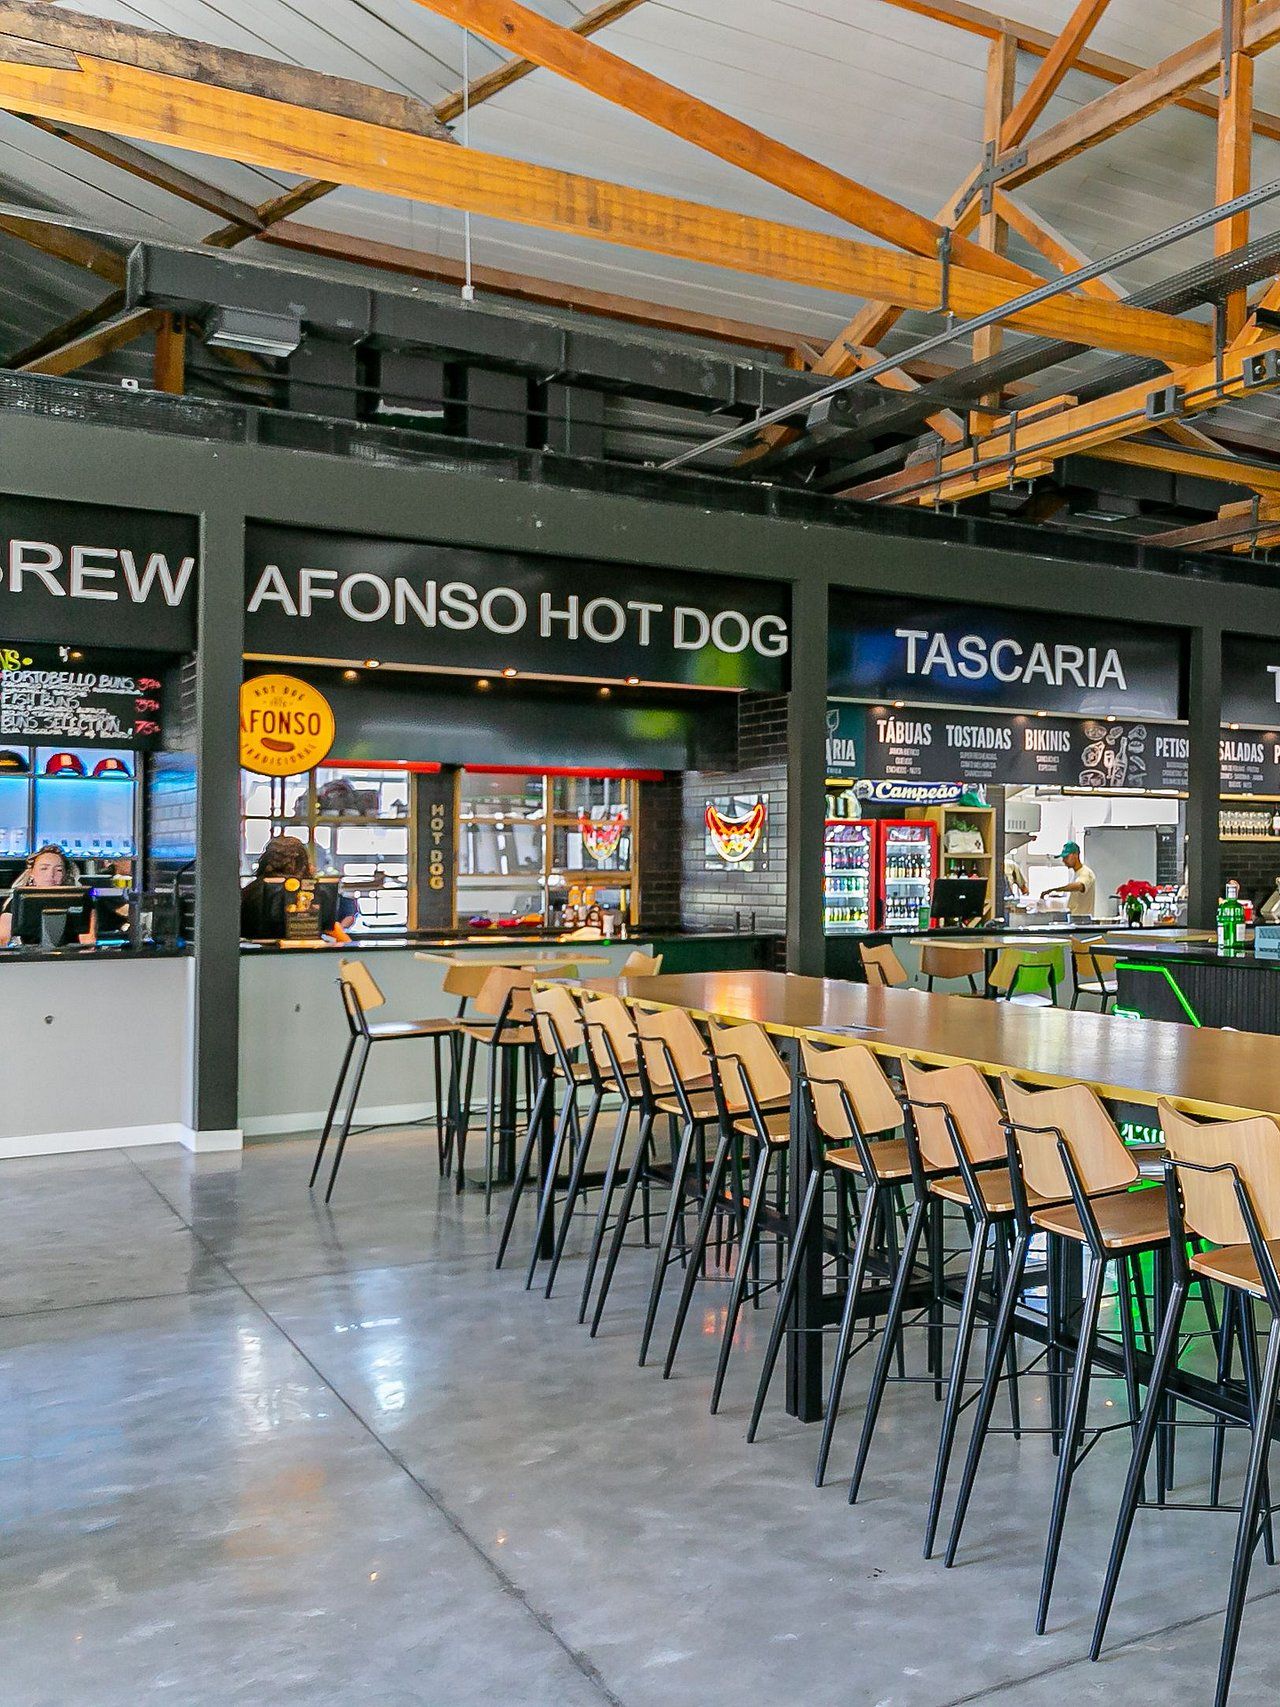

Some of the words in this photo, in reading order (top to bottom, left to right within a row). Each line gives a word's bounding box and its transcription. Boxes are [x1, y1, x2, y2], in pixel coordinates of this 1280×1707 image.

[0, 538, 195, 607] REW
[247, 564, 527, 635] AFONSO
[540, 592, 663, 647] HOT
[673, 606, 788, 658] DOG
[2, 670, 96, 687] PORTOBELLO
[98, 675, 135, 689] BUNS
[895, 628, 1127, 691] TASCARIA
[41, 694, 80, 709] BUNS
[1, 715, 38, 728] BUNS
[44, 714, 121, 732] SELECTION
[877, 716, 932, 746] TÁBUAS
[945, 725, 1012, 750] TOSTADAS
[1025, 729, 1071, 752] BIKINIS
[1155, 737, 1189, 758] PETIS
[1219, 740, 1265, 763] SALADAS
[875, 781, 961, 802] Campeão
[430, 804, 445, 845] HOT
[429, 849, 445, 890] DOG
